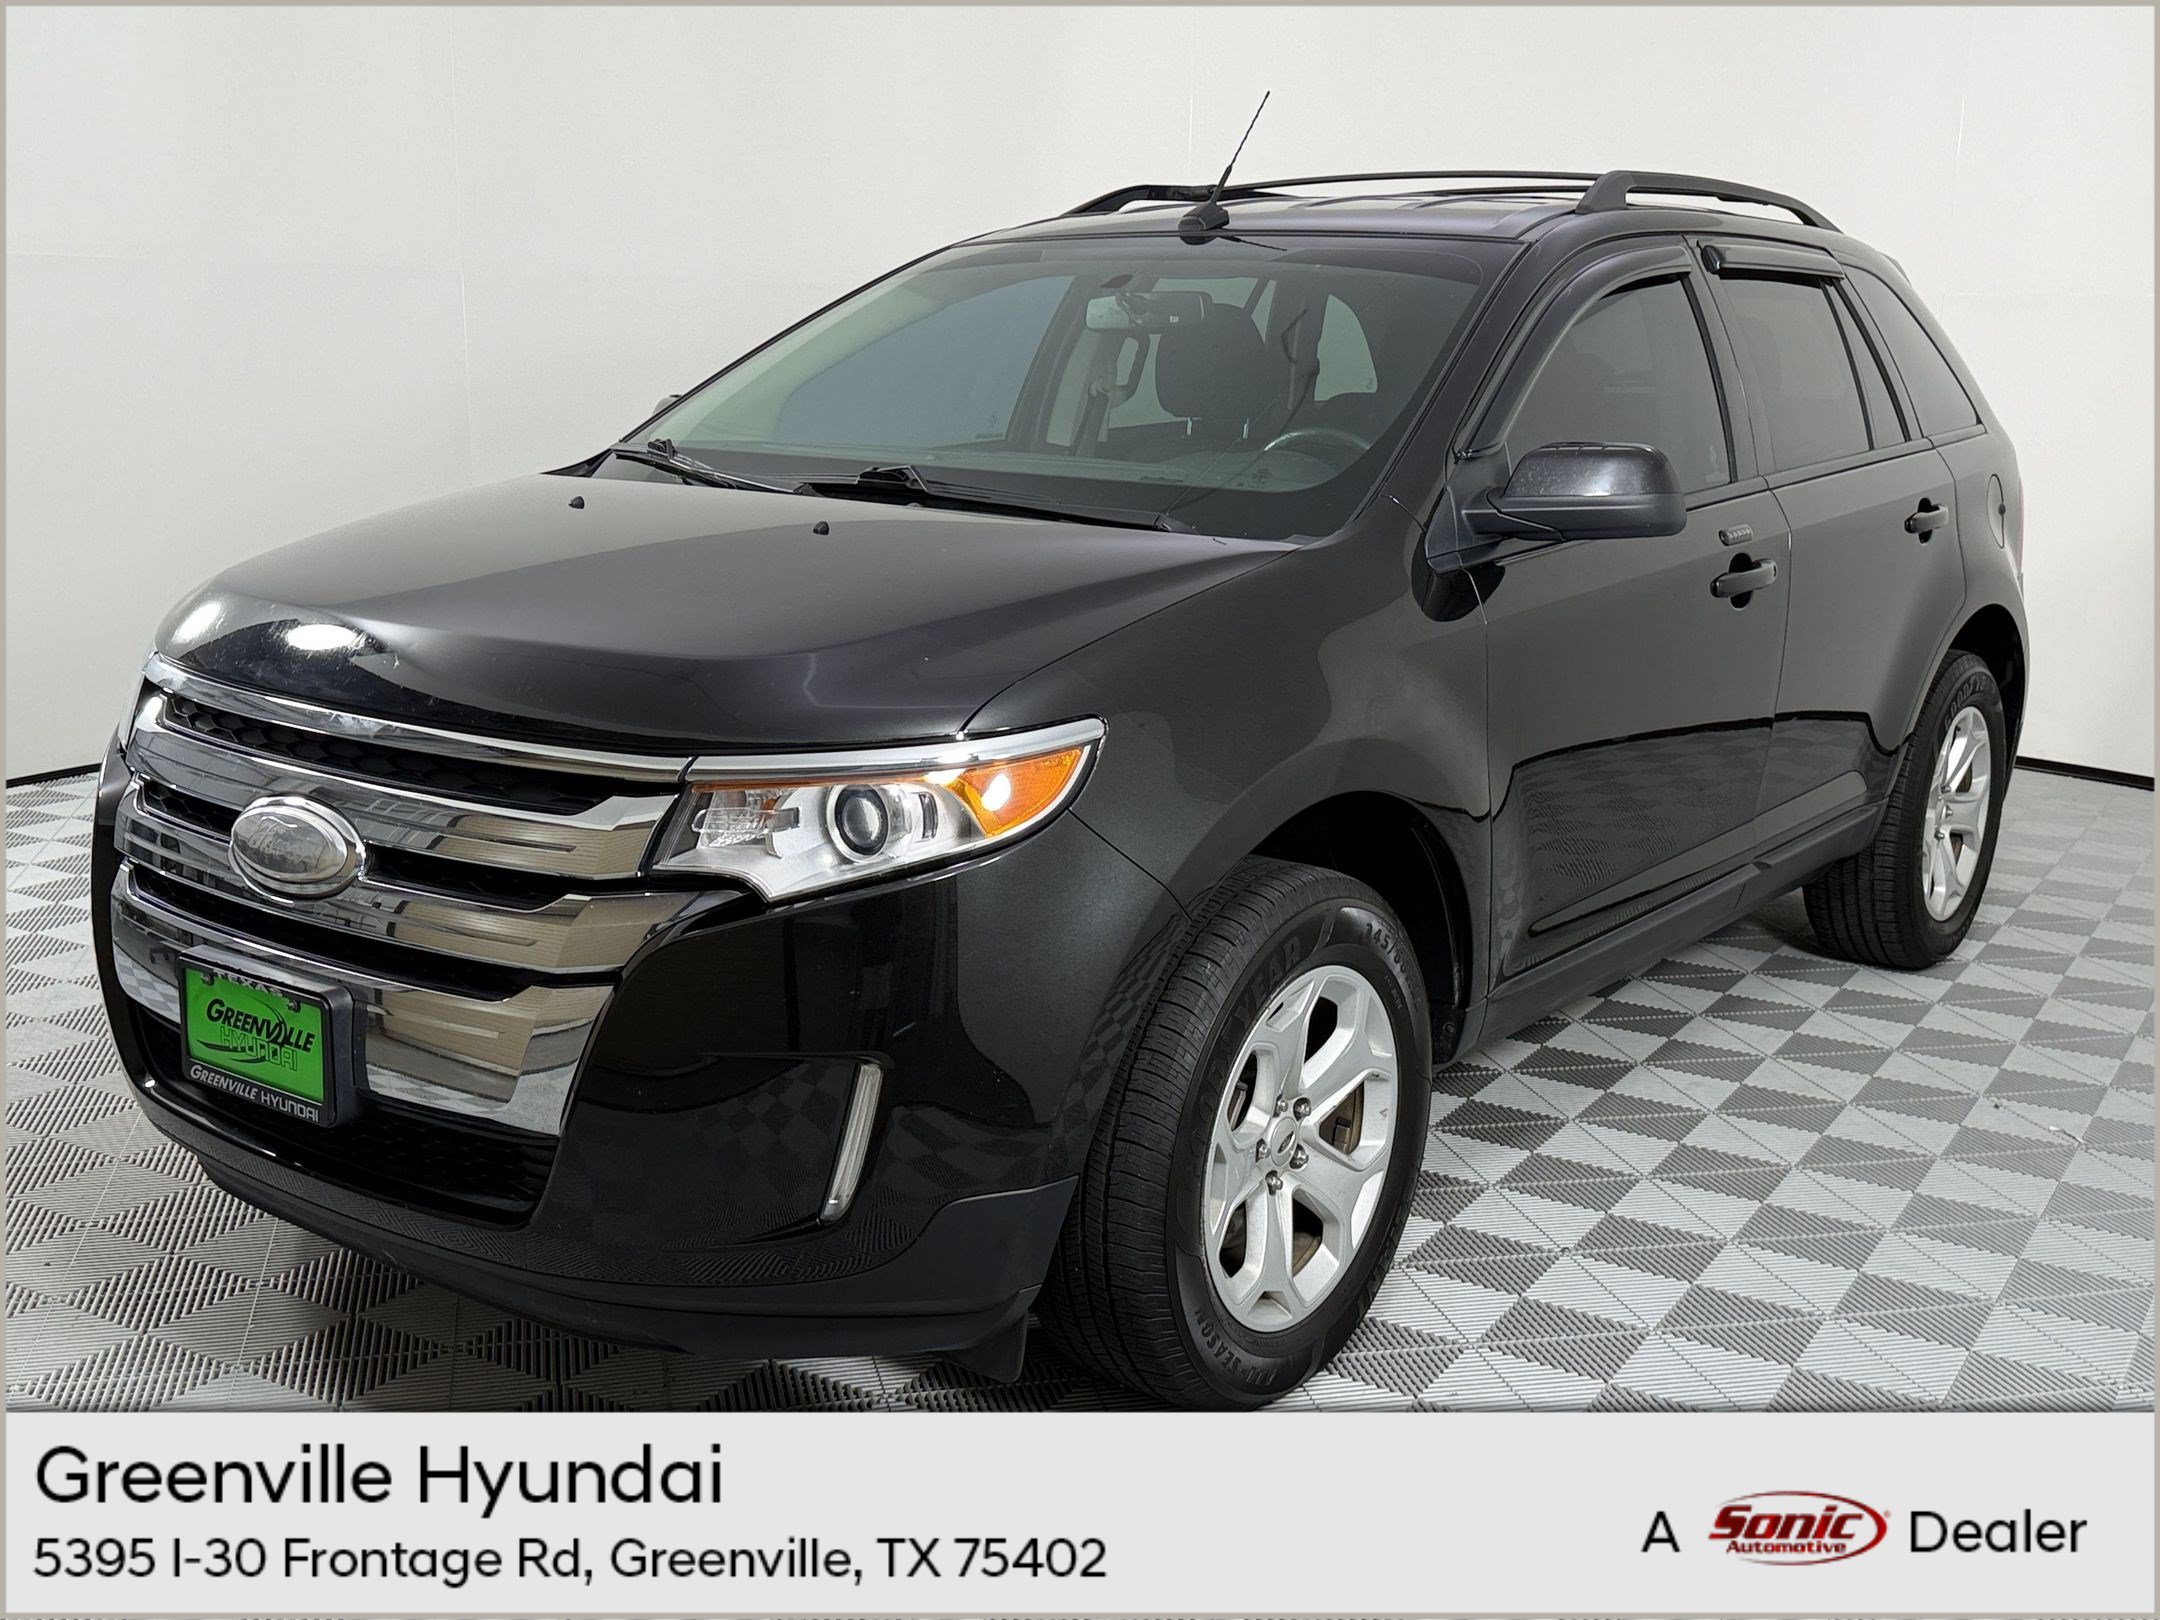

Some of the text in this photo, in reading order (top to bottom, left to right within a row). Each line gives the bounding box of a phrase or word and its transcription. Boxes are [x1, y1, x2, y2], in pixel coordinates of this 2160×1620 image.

[214, 969, 284, 997] TEXAS
[190, 1064, 319, 1122] GREENVILLE HYUNDAI
